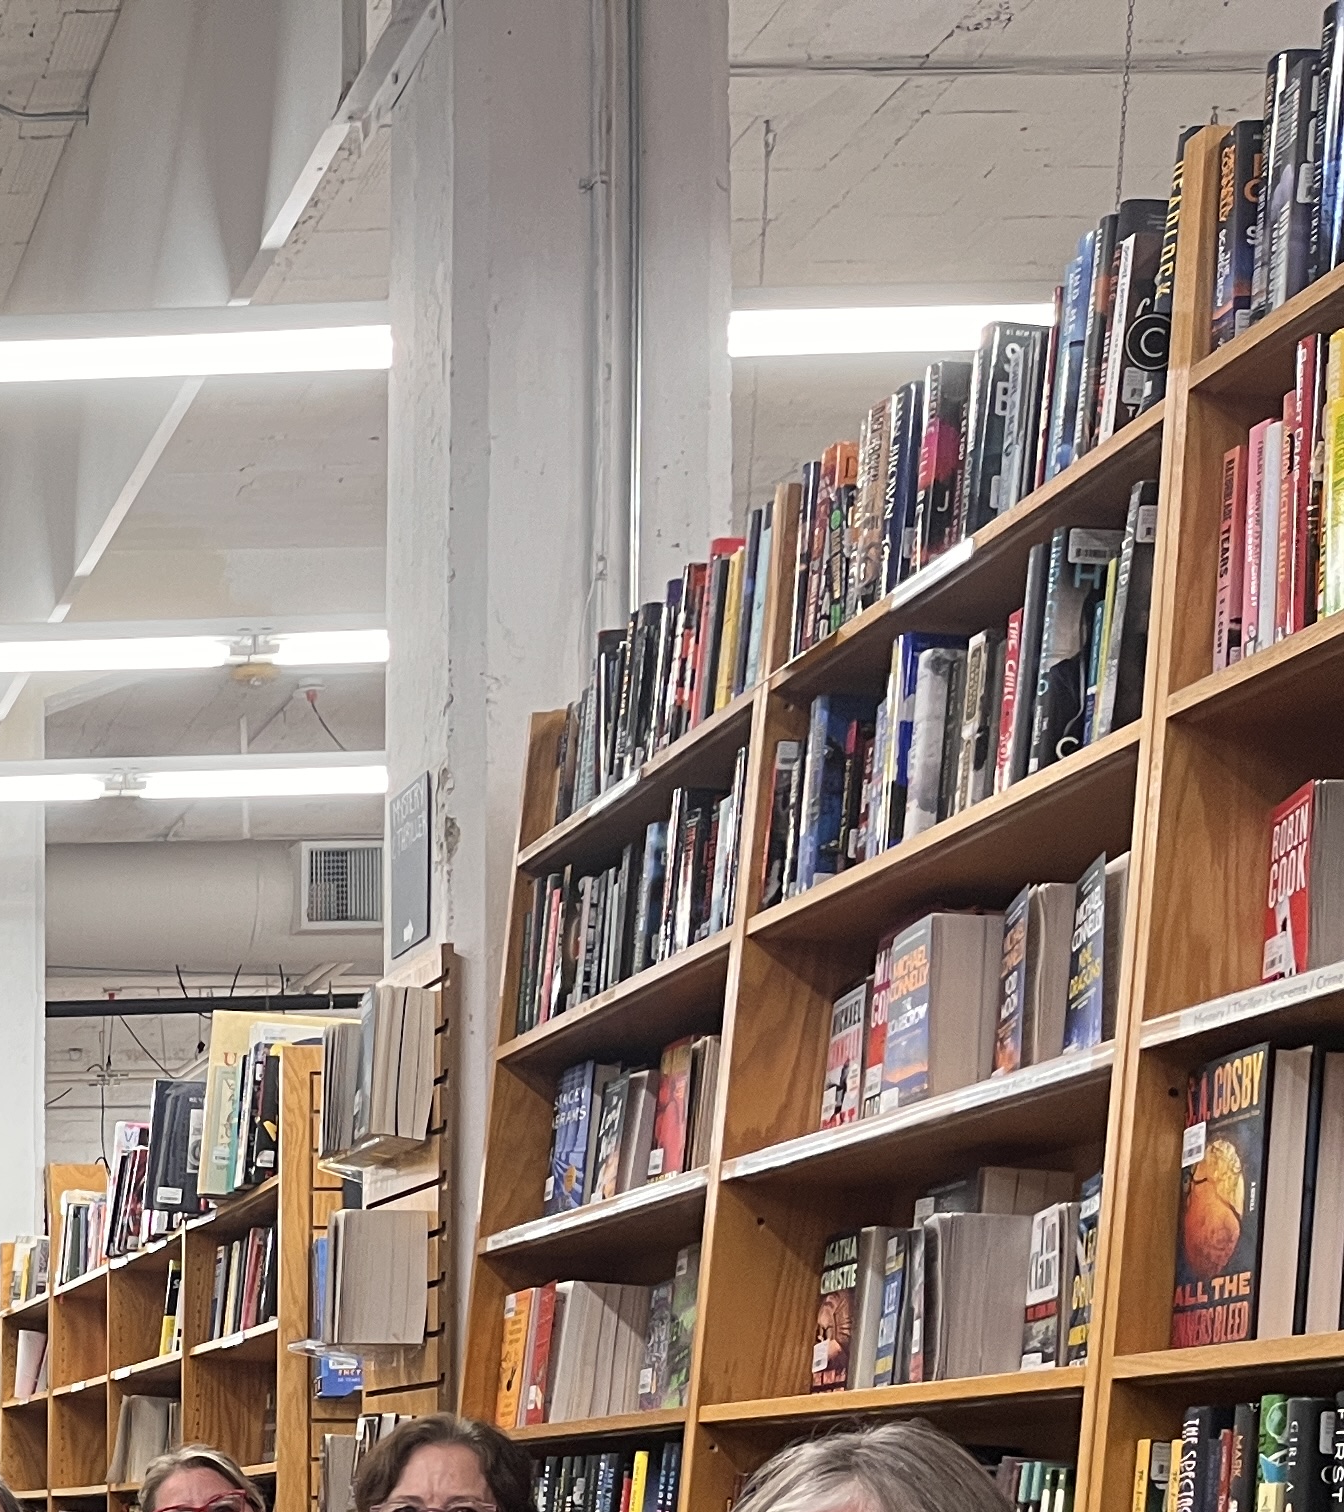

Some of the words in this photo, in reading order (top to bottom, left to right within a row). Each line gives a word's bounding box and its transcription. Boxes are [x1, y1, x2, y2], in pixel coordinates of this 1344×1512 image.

[883, 444, 901, 520] BROWN
[1219, 522, 1232, 579] TEARS
[1008, 621, 1019, 651] THE
[1003, 660, 1017, 701] CHILL
[1271, 802, 1310, 863] ROBIN
[1268, 841, 1308, 909] COOK
[893, 944, 928, 977] MICHAEL
[1315, 971, 1344, 991] Crime
[890, 963, 930, 1002] CONNELLY
[554, 1085, 588, 1112] STACEY
[1198, 1071, 1211, 1120] A.
[1213, 1051, 1265, 1119] COSBY
[823, 1235, 859, 1268] AGATHA
[820, 1263, 859, 1294] CHRISTIE
[1173, 1280, 1208, 1308] ALL
[1211, 1271, 1252, 1300] THE
[1213, 1300, 1250, 1342] BLEED
[1181, 1417, 1201, 1447] THE
[1287, 1420, 1299, 1467] GIRL
[1232, 1434, 1244, 1479] MARK
[1330, 1408, 1344, 1503] FIRST
